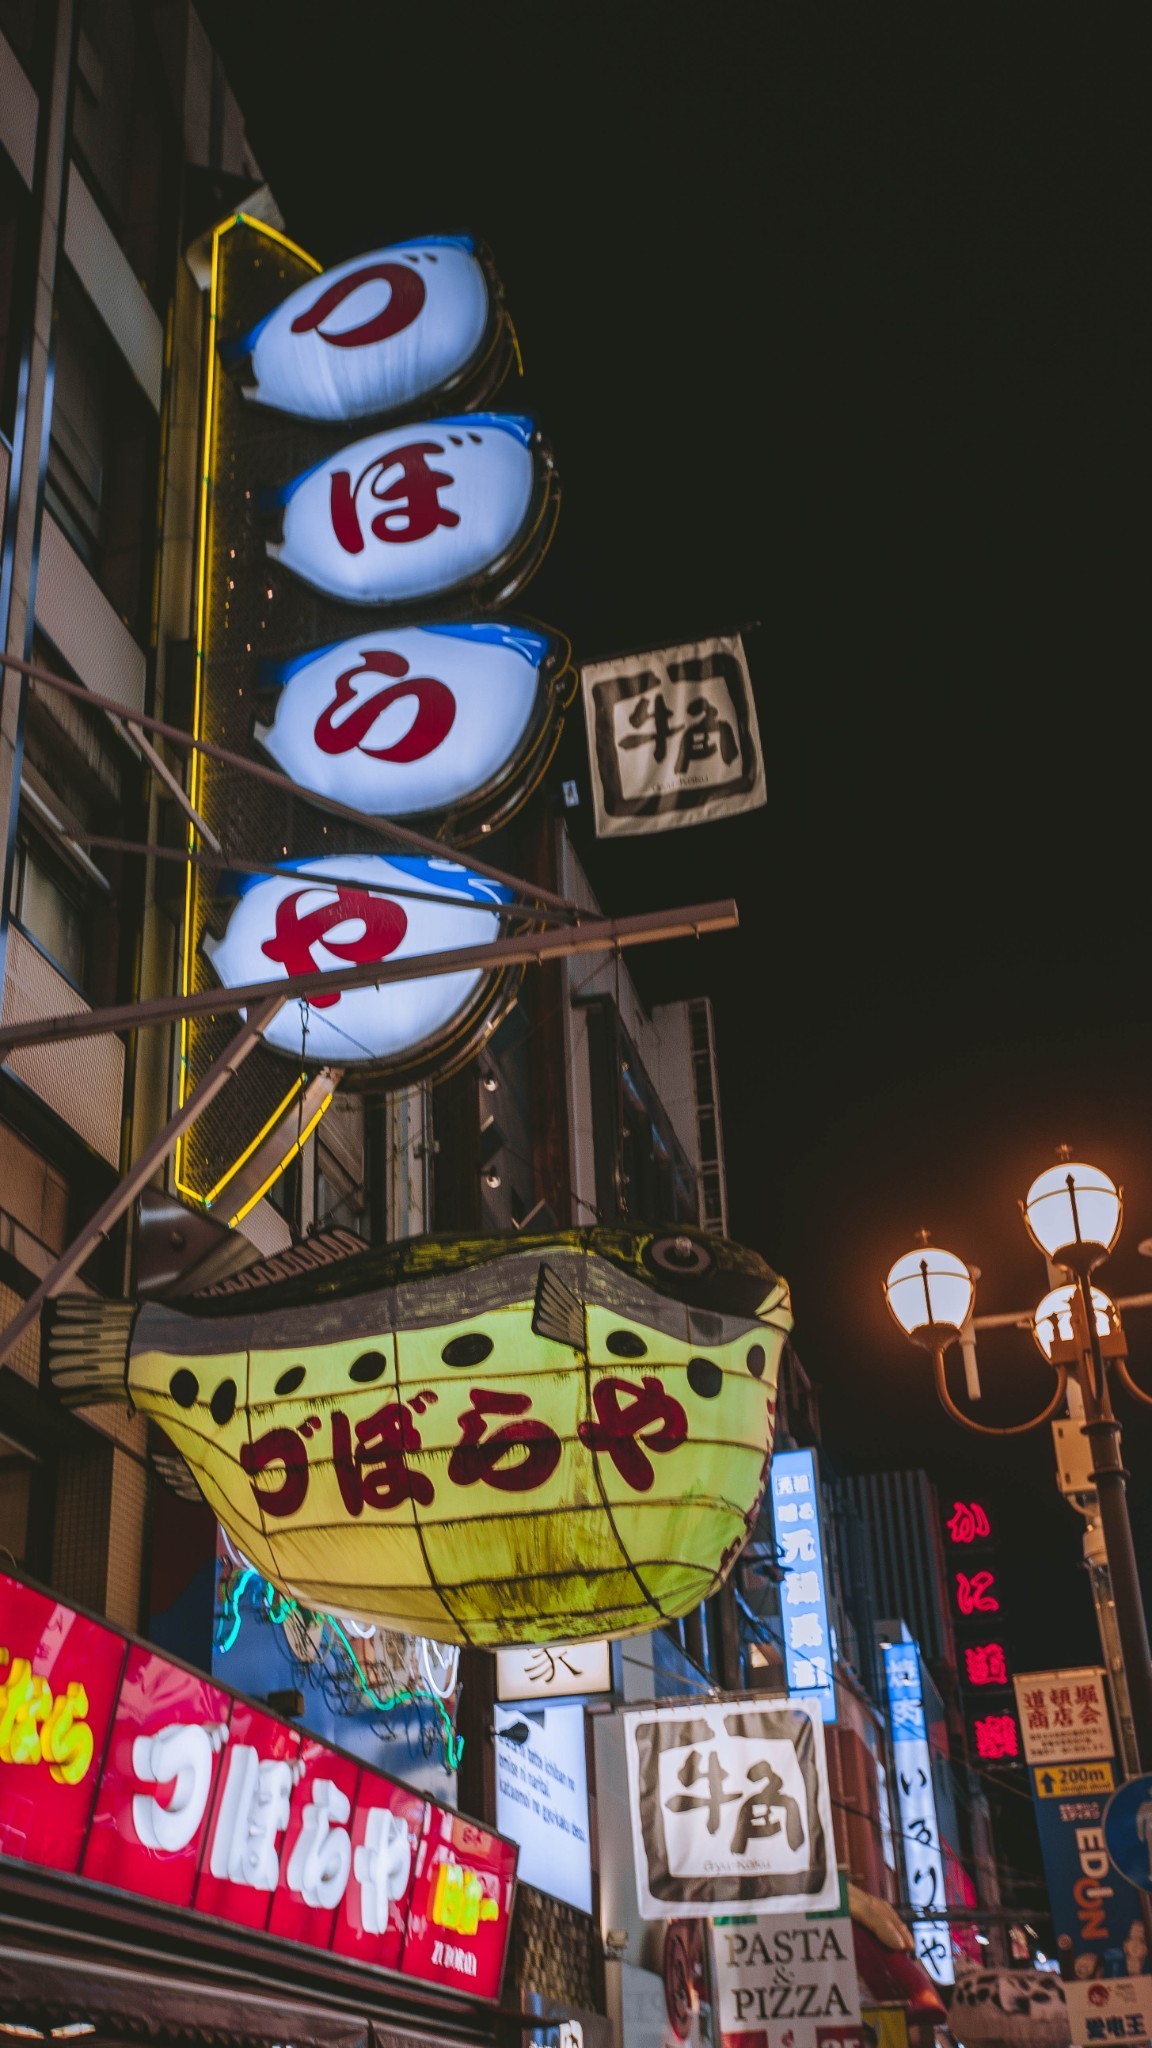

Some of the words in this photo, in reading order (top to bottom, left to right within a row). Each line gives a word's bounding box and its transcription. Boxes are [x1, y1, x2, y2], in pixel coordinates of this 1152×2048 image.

[617, 693, 740, 774] 牛角
[240, 1376, 690, 1516] づぼらや
[1024, 1684, 1100, 1709] 道頓堀
[1027, 1704, 1103, 1730] 商店会
[1058, 1767, 1105, 1784] 200m
[665, 1750, 806, 1855] 牛角
[1073, 1826, 1115, 1941] EDION
[725, 1926, 847, 1968] PASTA
[731, 1982, 852, 2021] PIZZA
